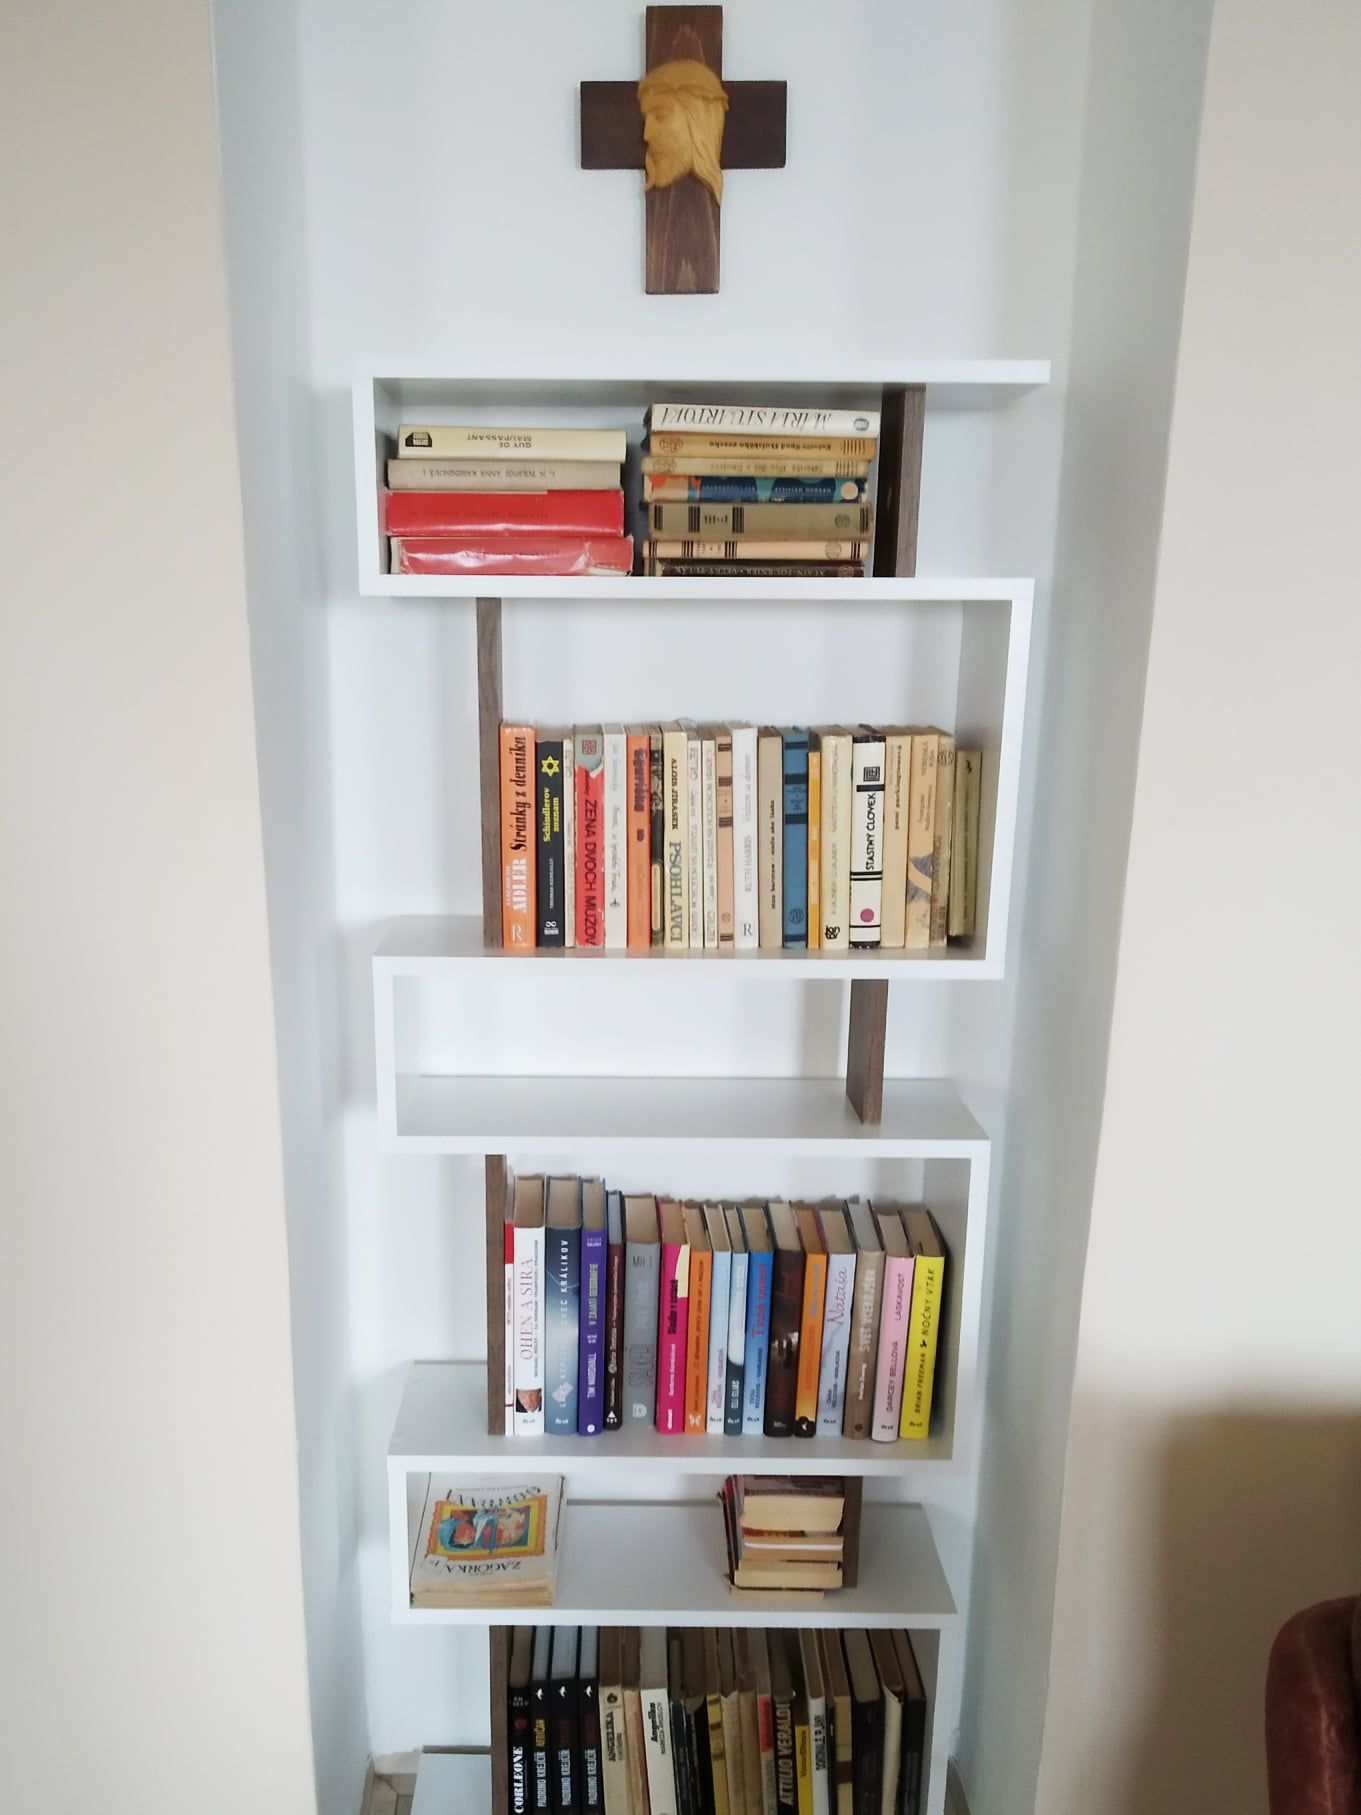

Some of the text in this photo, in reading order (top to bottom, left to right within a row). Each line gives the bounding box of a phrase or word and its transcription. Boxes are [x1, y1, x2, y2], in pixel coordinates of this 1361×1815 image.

[466, 433, 533, 443] MAUPASSANT
[671, 758, 679, 786] ALOIS
[508, 736, 532, 914] ADLER Stránky z denníka
[543, 787, 552, 842] Schindlerov
[585, 842, 597, 892] DVOCH
[669, 842, 684, 943] PSOHLAVCI
[557, 1239, 568, 1293] KRÁLIKOV
[519, 1300, 533, 1314] A
[859, 1325, 872, 1352] SVET
[916, 1352, 926, 1389] FREEMAN
[587, 1387, 597, 1398] TIM
[885, 1379, 896, 1412] DARCEY
[914, 1390, 922, 1414] BRIAN
[445, 1560, 521, 1574] ZAGORKA
[605, 1711, 617, 1763] ANGELIKA
[648, 1702, 660, 1743] Angelika
[513, 1746, 525, 1814] CORLEONE
[537, 1779, 547, 1807] PADRINO
[561, 1777, 572, 1806] PADRINO
[587, 1777, 598, 1805] PADRINO
[778, 1759, 795, 1806] ATTILIO
